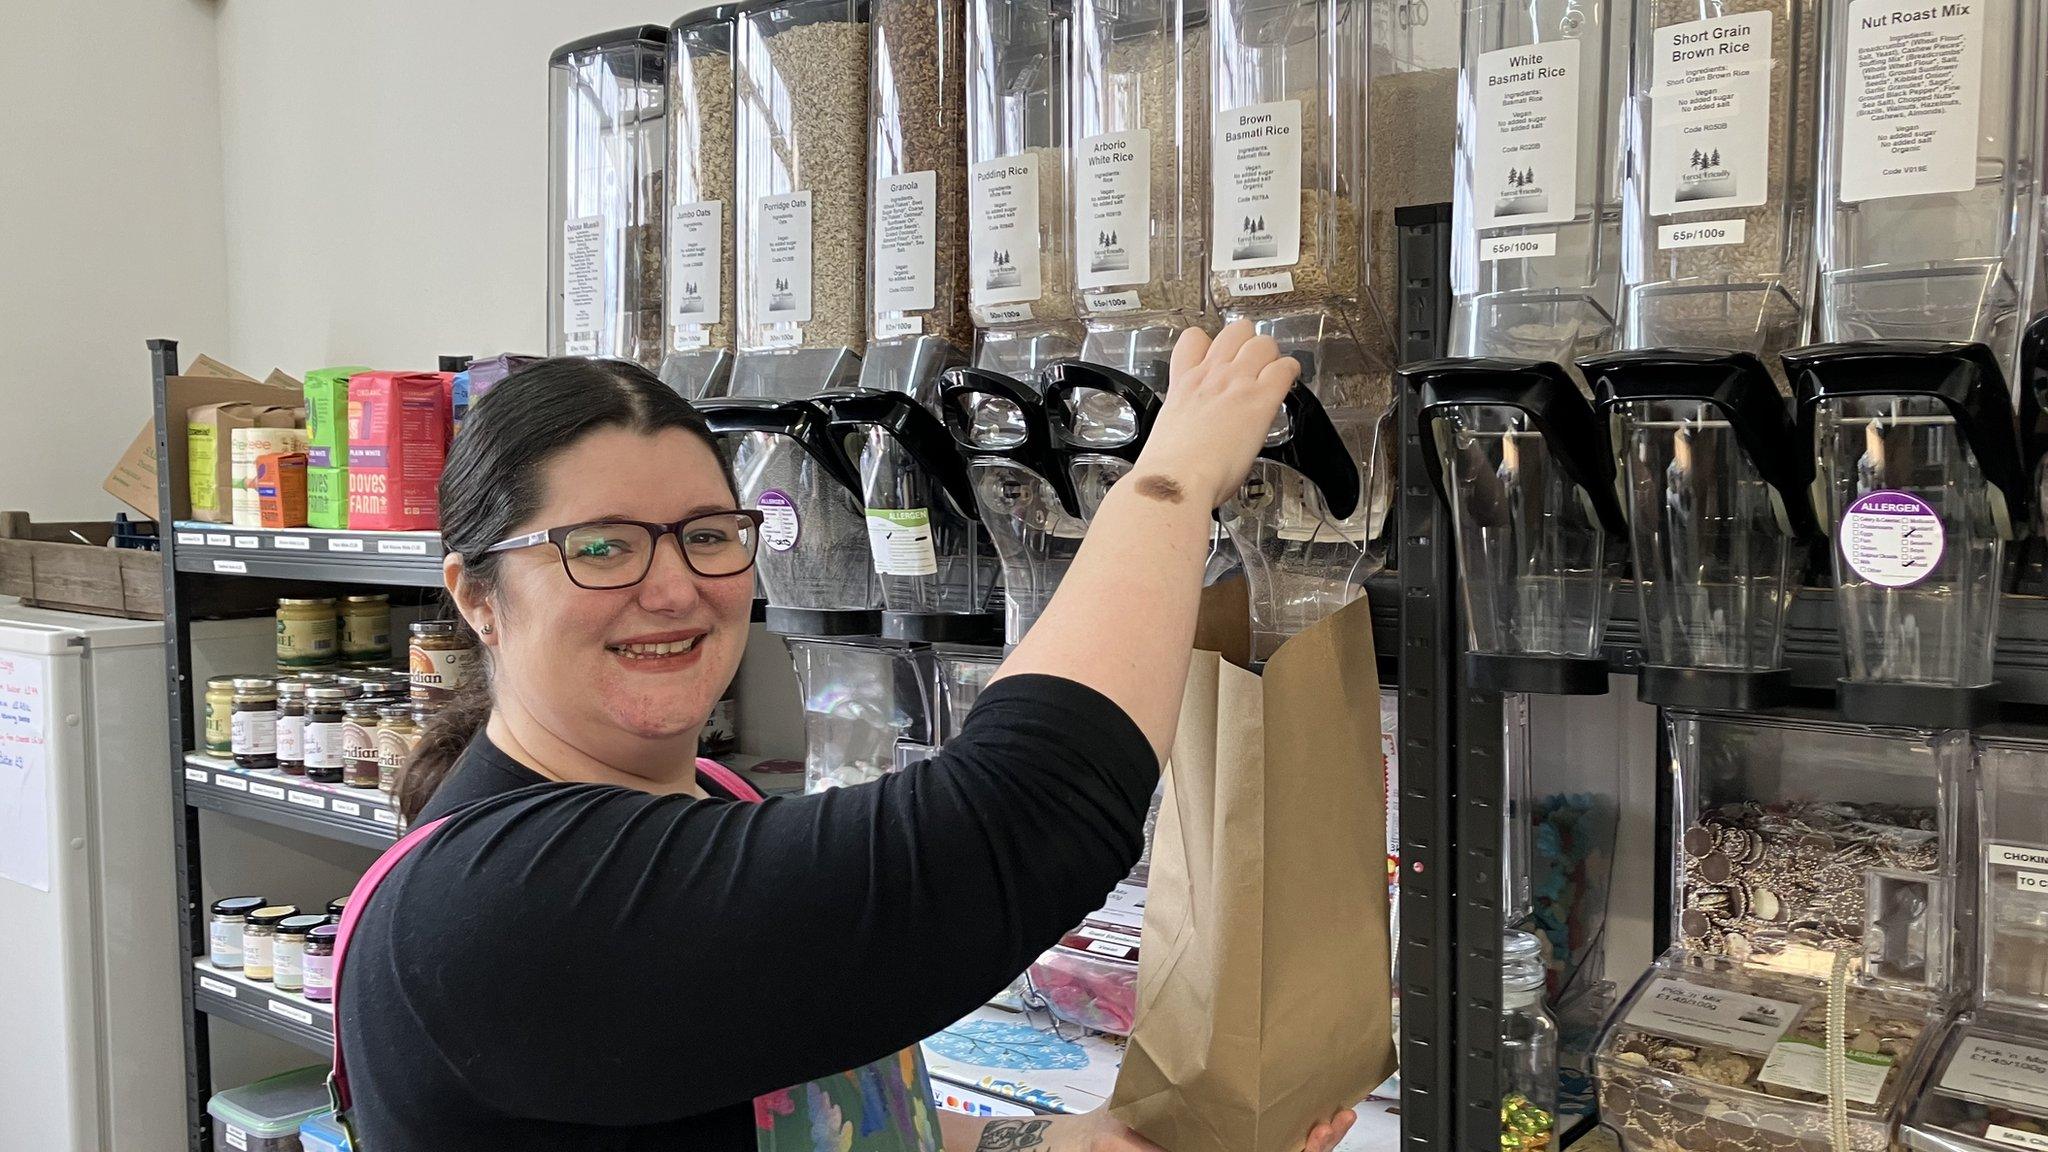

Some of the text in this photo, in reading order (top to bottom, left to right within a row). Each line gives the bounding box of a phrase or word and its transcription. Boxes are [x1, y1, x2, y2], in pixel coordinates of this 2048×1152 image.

[1862, 4, 1970, 29] Nut Roast Mix
[1673, 25, 1751, 46] Short Grain
[1673, 43, 1750, 62] Brown Rice
[1510, 55, 1543, 67] White
[1489, 67, 1566, 86] Basmati Rice
[1666, 79, 1685, 87] Short
[1687, 76, 1706, 84] Grain
[1707, 73, 1731, 81] Brown
[1503, 98, 1527, 106] Basmati
[1713, 94, 1735, 102] sugar
[1693, 103, 1715, 111] added
[1240, 114, 1272, 126] Brown
[1226, 125, 1290, 142] Basmati Rice
[1684, 126, 1702, 134] Code
[1896, 125, 1920, 133] Vegan
[1890, 132, 1912, 140] added
[1914, 130, 1937, 138] sugar
[1094, 140, 1126, 153] Arborio
[1892, 145, 1921, 154] Organic
[1089, 153, 1134, 166] White Rice
[978, 166, 1028, 182] Pudding Rice
[1882, 168, 1902, 176] Code
[891, 181, 918, 192] Granola
[764, 200, 807, 211] Porridge Oats
[1673, 228, 1725, 241] 65p/100g
[1493, 242, 1539, 254] 65p/100g
[1239, 281, 1278, 291] 65p/100g
[1861, 503, 1920, 513] ALLERGEN
[889, 511, 927, 520] ALLERGEN
[2020, 877, 2035, 886] TO
[1974, 1046, 2002, 1057] Pick
